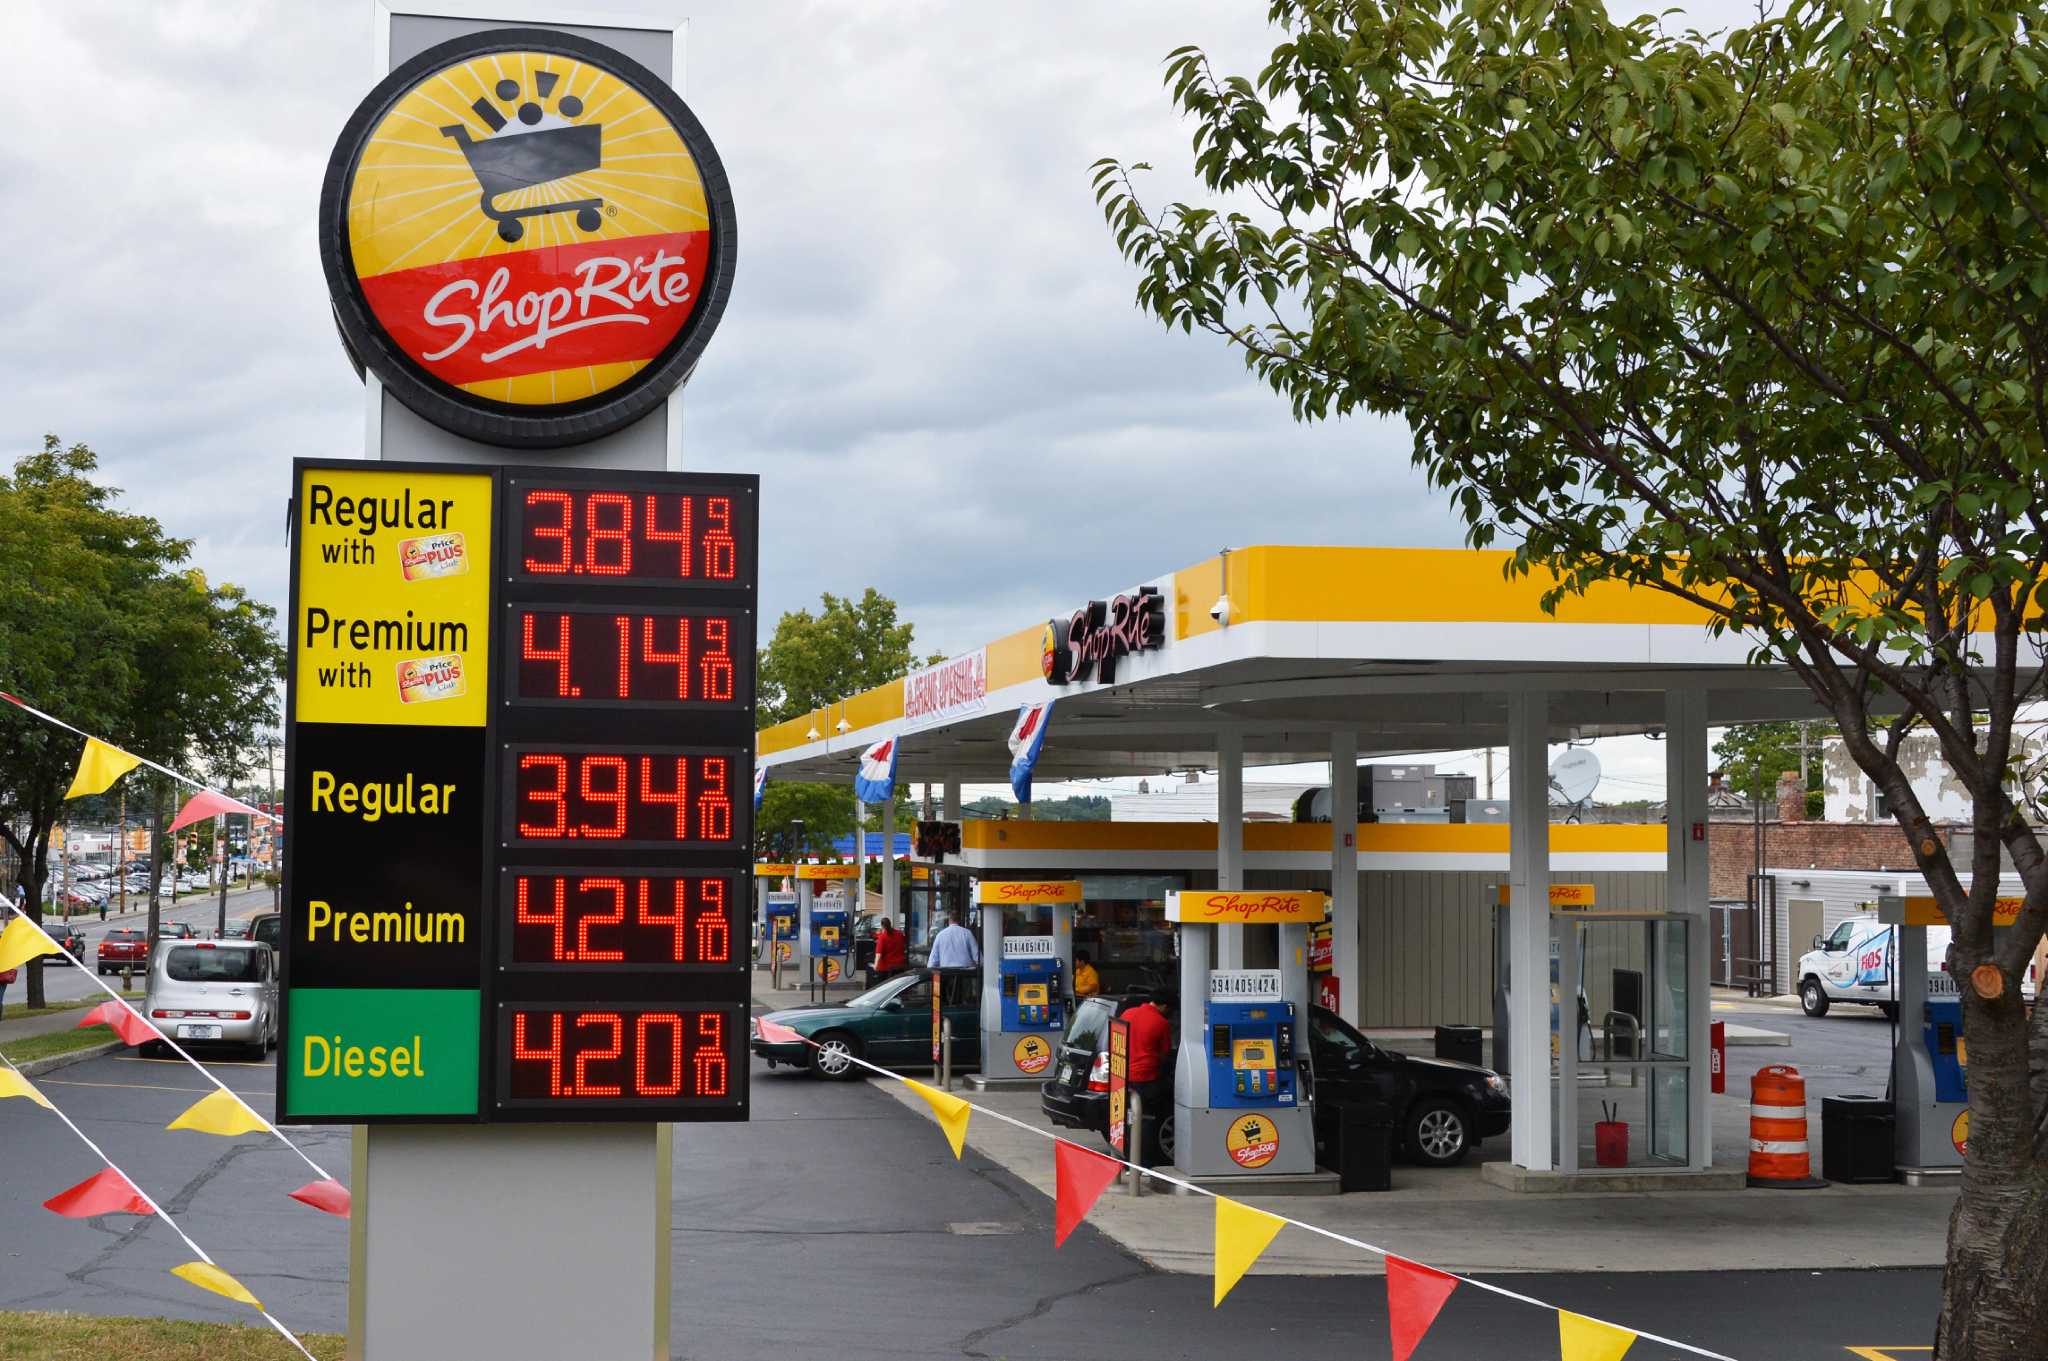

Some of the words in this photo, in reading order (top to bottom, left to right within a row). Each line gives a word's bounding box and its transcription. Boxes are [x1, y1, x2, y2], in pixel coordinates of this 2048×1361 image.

[422, 248, 690, 364] ShopRite
[310, 484, 454, 536] Regular
[321, 537, 376, 565] with
[426, 544, 464, 565] PLUS
[525, 490, 693, 578] 3.84
[306, 607, 468, 652] Premium
[1065, 594, 1151, 684] ShopRite
[318, 660, 372, 688] with
[424, 666, 461, 686] PLUS
[523, 614, 690, 699] 4.14
[312, 771, 456, 822] Regular
[519, 754, 687, 840] 3.94
[999, 884, 1065, 901] ShopRite
[1204, 895, 1302, 919] ShopRite
[308, 901, 465, 943] Premium
[517, 878, 685, 961] 4.24
[1212, 979, 1230, 993] 394
[1235, 979, 1253, 993] 405
[1258, 979, 1276, 993] 424
[304, 1035, 424, 1077] Diesel
[515, 1012, 683, 1096] 4.20
